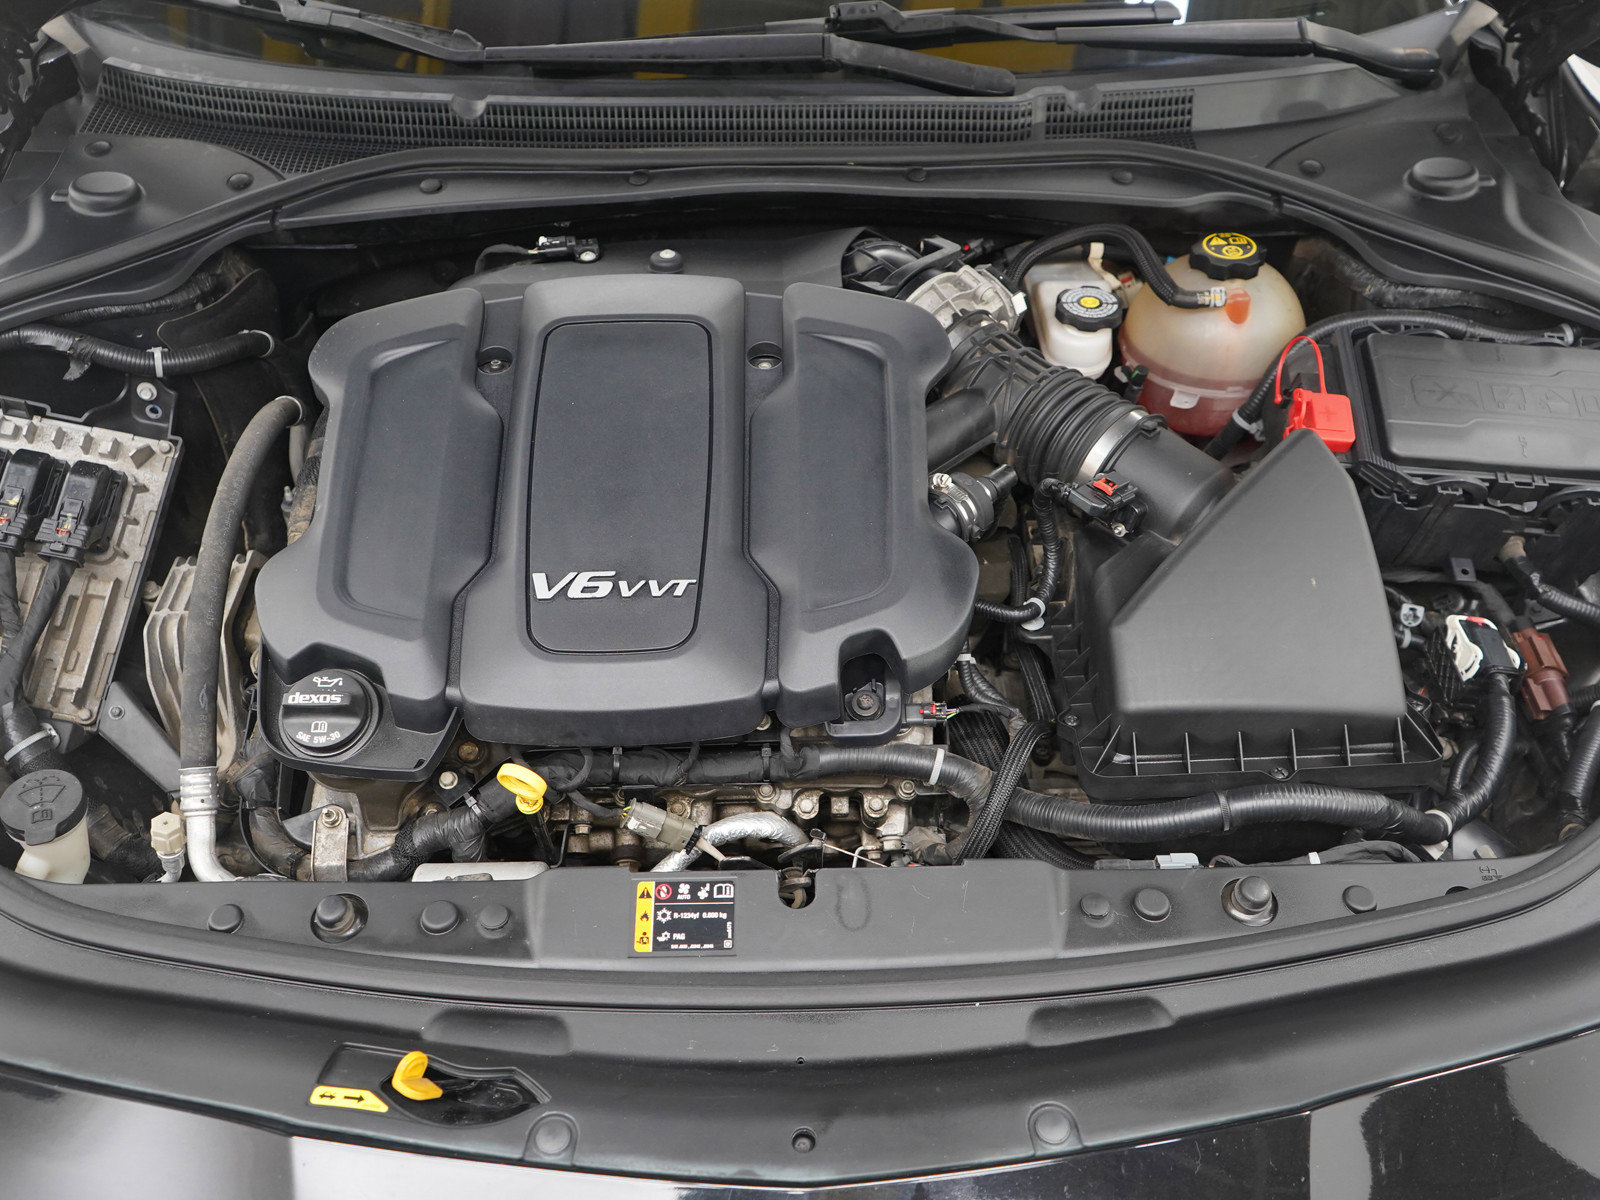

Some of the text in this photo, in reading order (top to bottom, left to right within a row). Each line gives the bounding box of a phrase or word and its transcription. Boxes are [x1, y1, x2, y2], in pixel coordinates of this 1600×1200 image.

[532, 571, 697, 600] V6 VVT
[287, 691, 342, 704] dexos
[296, 731, 341, 744] SAE 5W-30
[719, 911, 727, 919] kg
